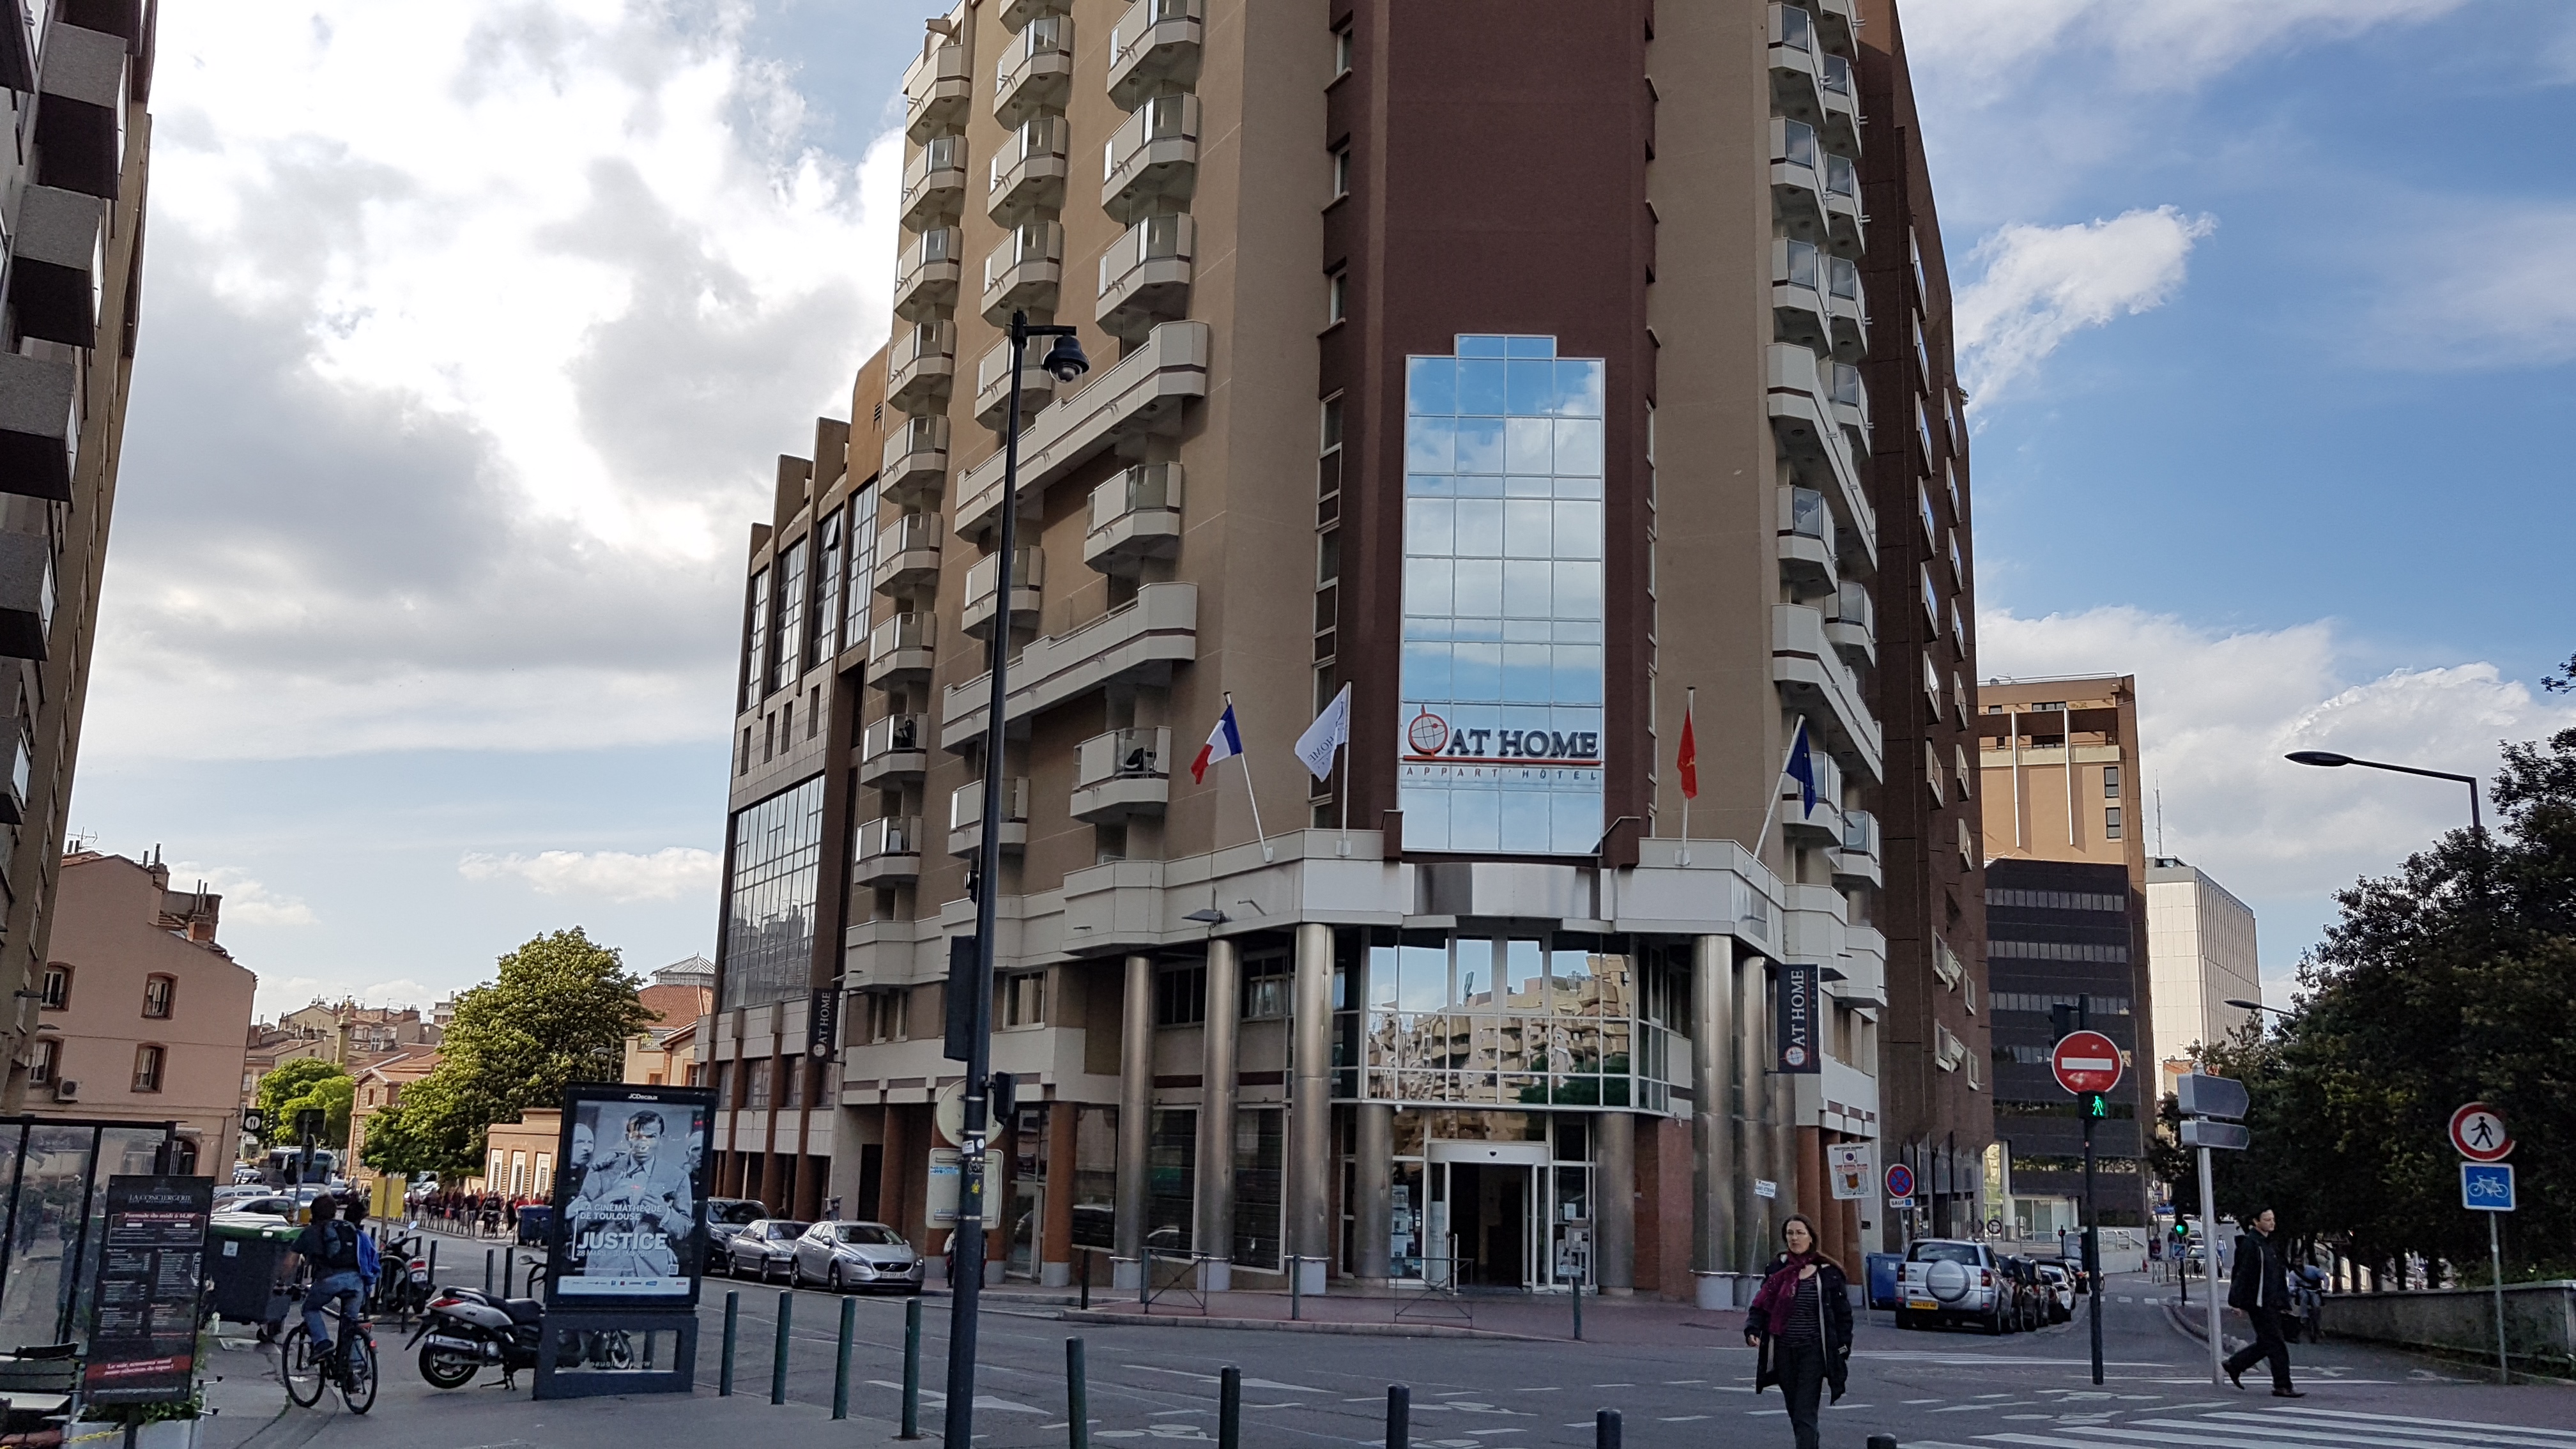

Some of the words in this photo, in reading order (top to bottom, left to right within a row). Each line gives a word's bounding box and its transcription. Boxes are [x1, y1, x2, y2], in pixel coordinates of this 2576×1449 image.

[1447, 728, 1491, 755] AT
[1498, 730, 1598, 758] HOME
[1791, 970, 1805, 1020] HOME
[820, 992, 831, 1026] HOME
[818, 1029, 827, 1044] AT
[1792, 1024, 1805, 1046] AT
[594, 1203, 662, 1213] CINÉMATHÈQUE
[594, 1212, 641, 1220] TOULOUSE
[577, 1232, 668, 1250] JUSTICE
